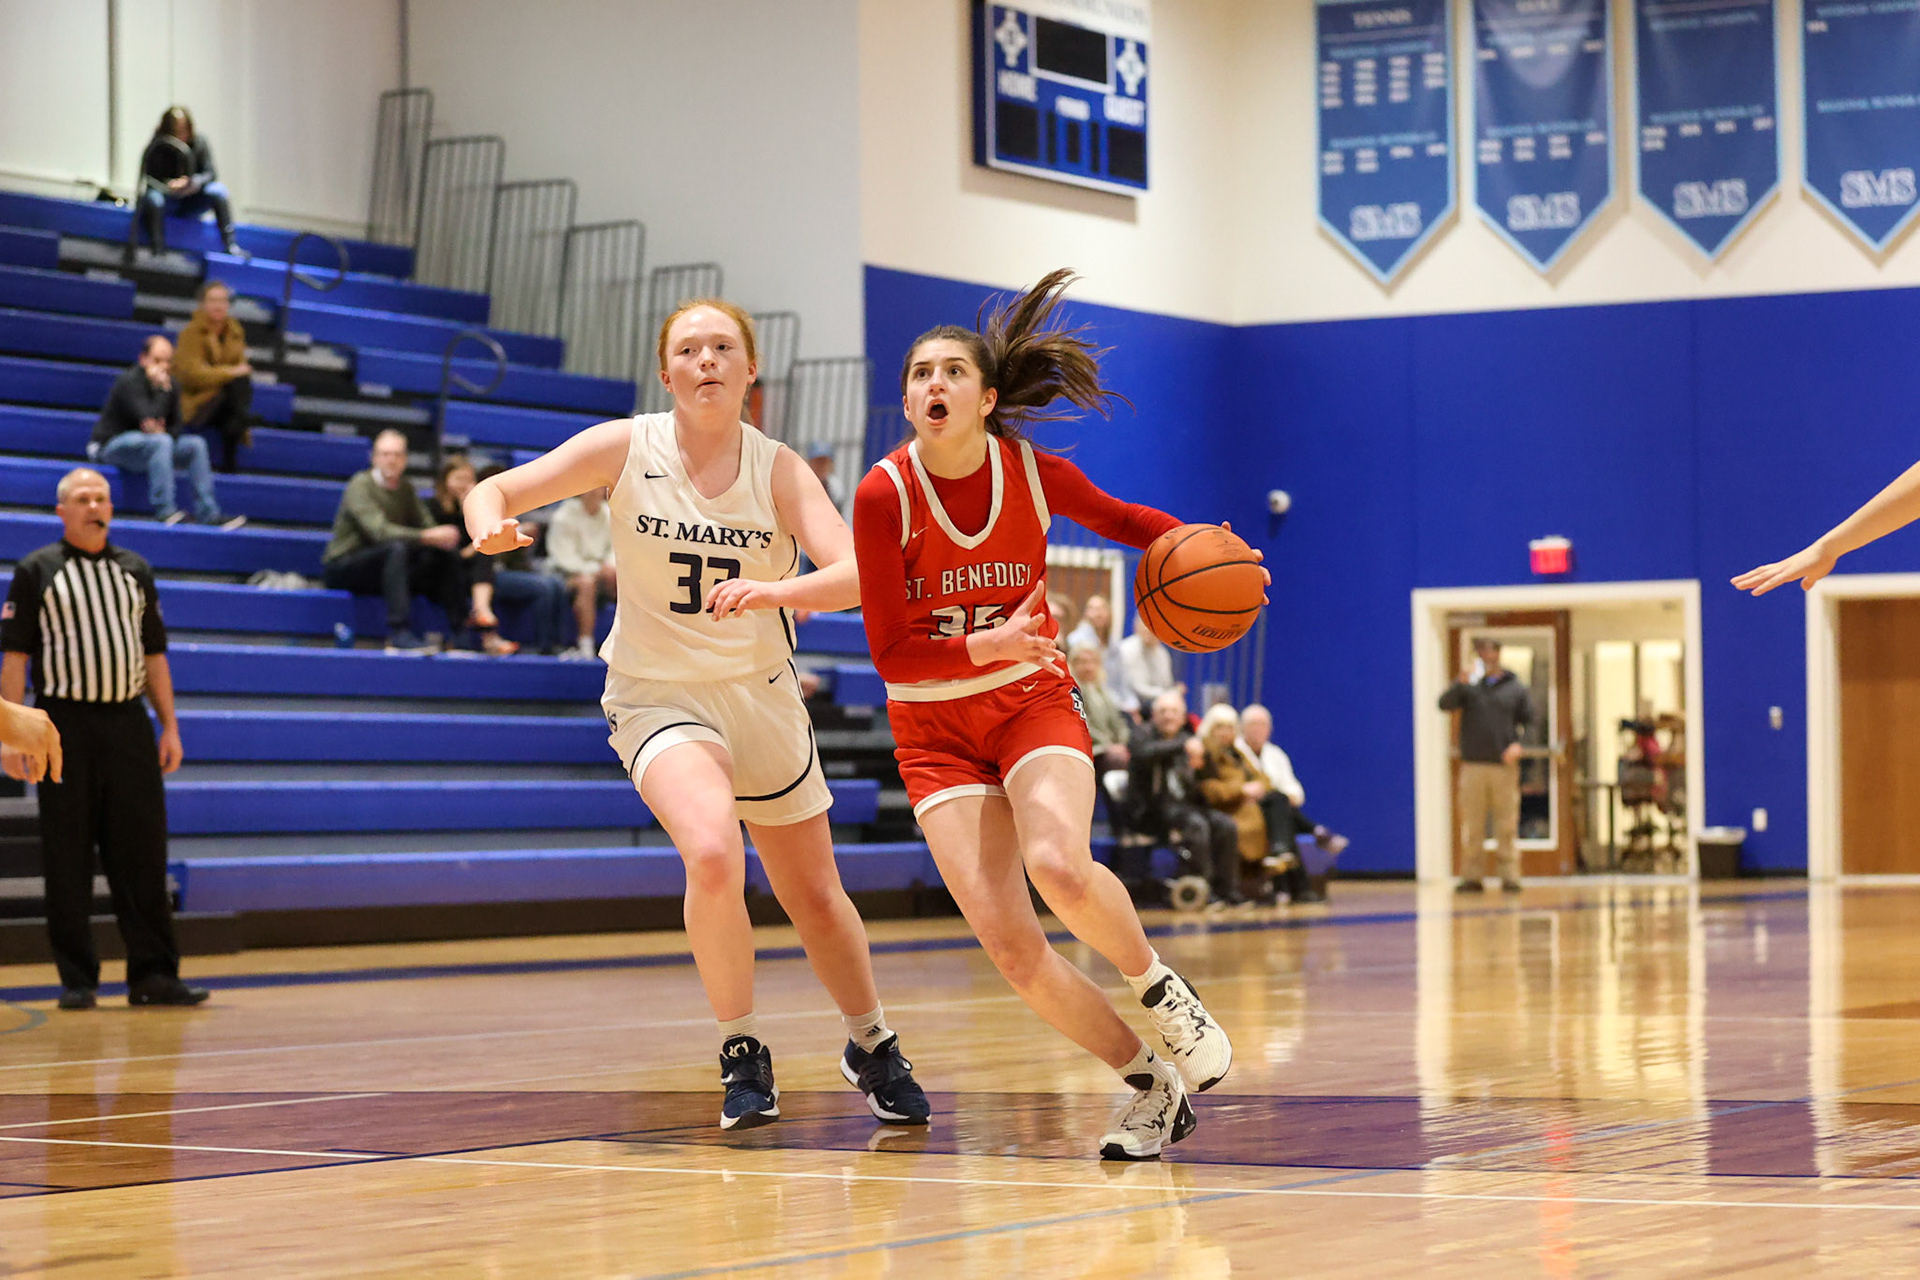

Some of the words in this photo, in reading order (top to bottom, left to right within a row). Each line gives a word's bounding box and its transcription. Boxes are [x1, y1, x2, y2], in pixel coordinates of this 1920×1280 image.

[1840, 167, 1917, 208] SMS
[636, 514, 669, 538] ST.
[674, 522, 773, 549] MARY'S
